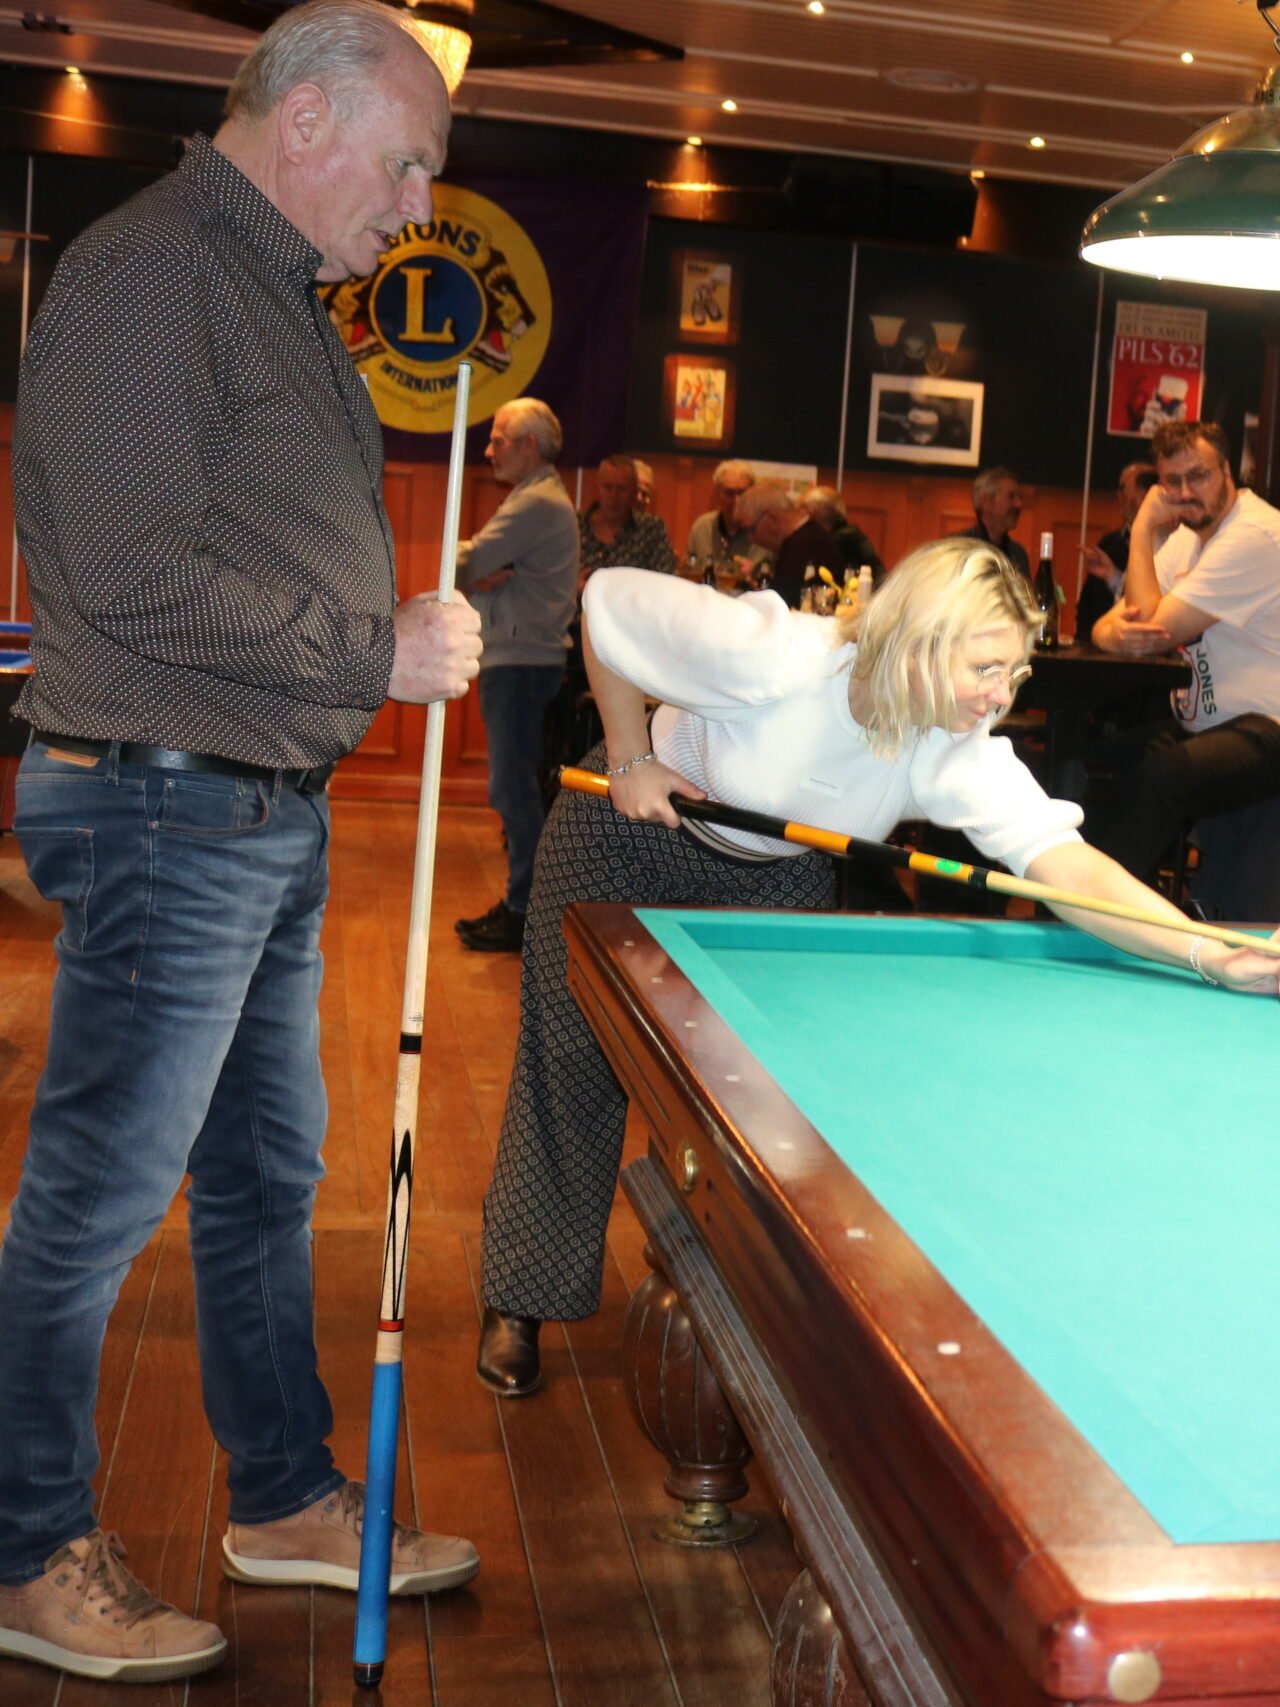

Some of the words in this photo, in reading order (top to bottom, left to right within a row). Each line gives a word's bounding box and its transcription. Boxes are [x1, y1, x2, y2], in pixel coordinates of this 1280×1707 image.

[391, 219, 481, 256] IONS
[397, 266, 455, 344] L
[1118, 337, 1163, 365] PILS
[1197, 648, 1217, 715] JONES
